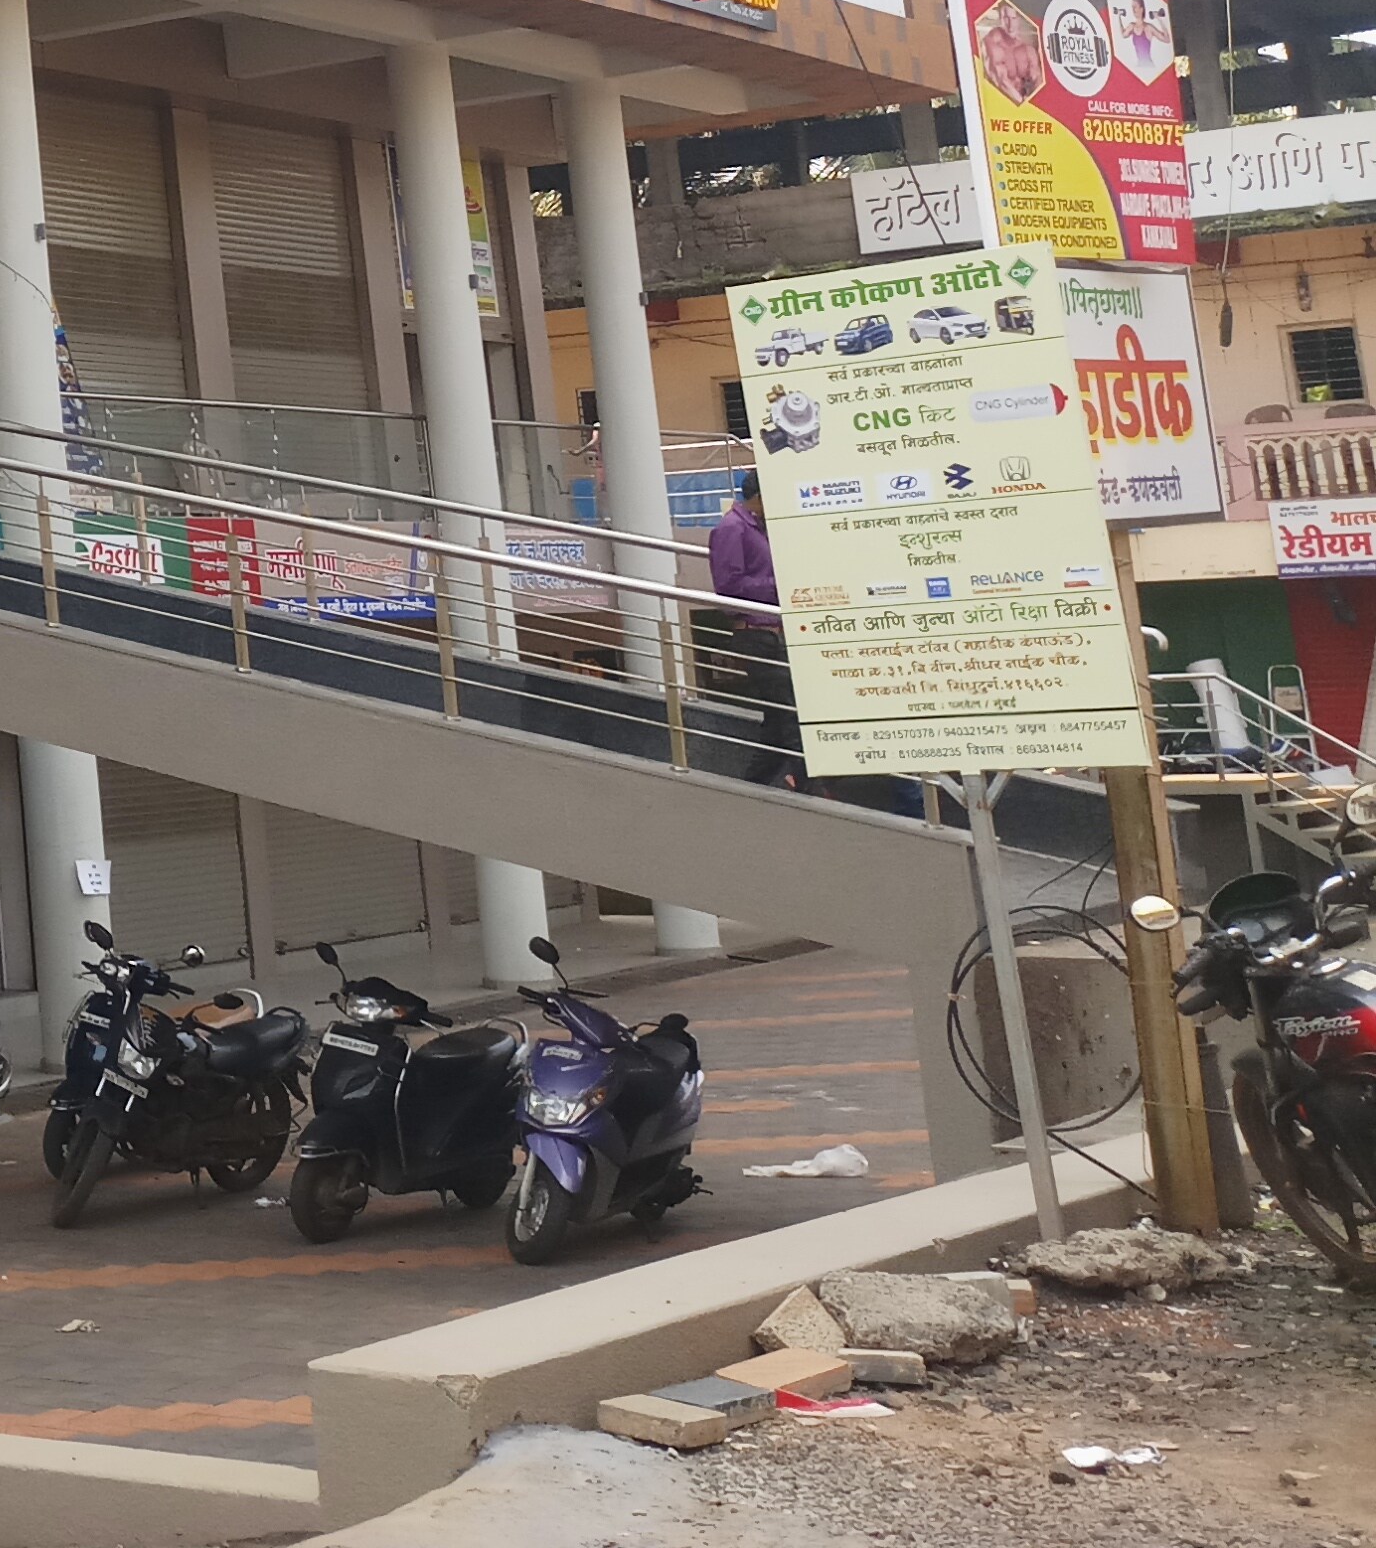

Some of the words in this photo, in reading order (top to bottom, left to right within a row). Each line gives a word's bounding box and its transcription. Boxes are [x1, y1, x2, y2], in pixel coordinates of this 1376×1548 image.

[1061, 35, 1094, 52] ROYAL
[1063, 51, 1095, 65] FITNESS
[1088, 100, 1109, 113] CALL
[1109, 101, 1127, 114] FOR
[1127, 103, 1151, 116] MORE
[990, 118, 1010, 133] WE
[1013, 120, 1053, 135] OFFER
[1082, 118, 1185, 147] 8208508875
[1001, 142, 1037, 158] CARDIO
[1004, 160, 1054, 176] STRENGTH
[1006, 178, 1039, 193] CROSS
[1039, 180, 1054, 193] FIT
[864, 174, 962, 242] हॉटेल
[1009, 196, 1056, 212] CERTIFIED
[1056, 198, 1096, 214] TRAINER
[1011, 214, 1051, 229] MODERN
[1052, 215, 1108, 232] EQUIPMENTS
[1060, 234, 1118, 250] CONDITIONED
[1011, 266, 1033, 279] CNG
[767, 287, 825, 321] ग्रीन
[830, 278, 924, 309] कोकण
[930, 259, 1004, 296] ऑटो
[826, 365, 848, 383] सर्व
[853, 407, 912, 432] CNG
[918, 404, 956, 425] किट
[856, 438, 898, 457] बसवून
[823, 486, 862, 497] SUZUKI
[886, 490, 926, 501] HYUNDAI
[992, 482, 1046, 495] HONDA
[954, 509, 986, 523] स्वस्त
[989, 505, 1019, 521] दरात
[898, 528, 963, 551] इन्शुरन्स
[1278, 524, 1373, 559] रेडीयम
[92, 541, 158, 576] Castrl
[812, 615, 857, 634] नविन
[863, 610, 907, 631] आणि
[912, 611, 955, 633] जुन्या
[962, 603, 1005, 625] ऑटो
[1010, 601, 1049, 621] रिक्षा
[1054, 596, 1098, 618] विक्री
